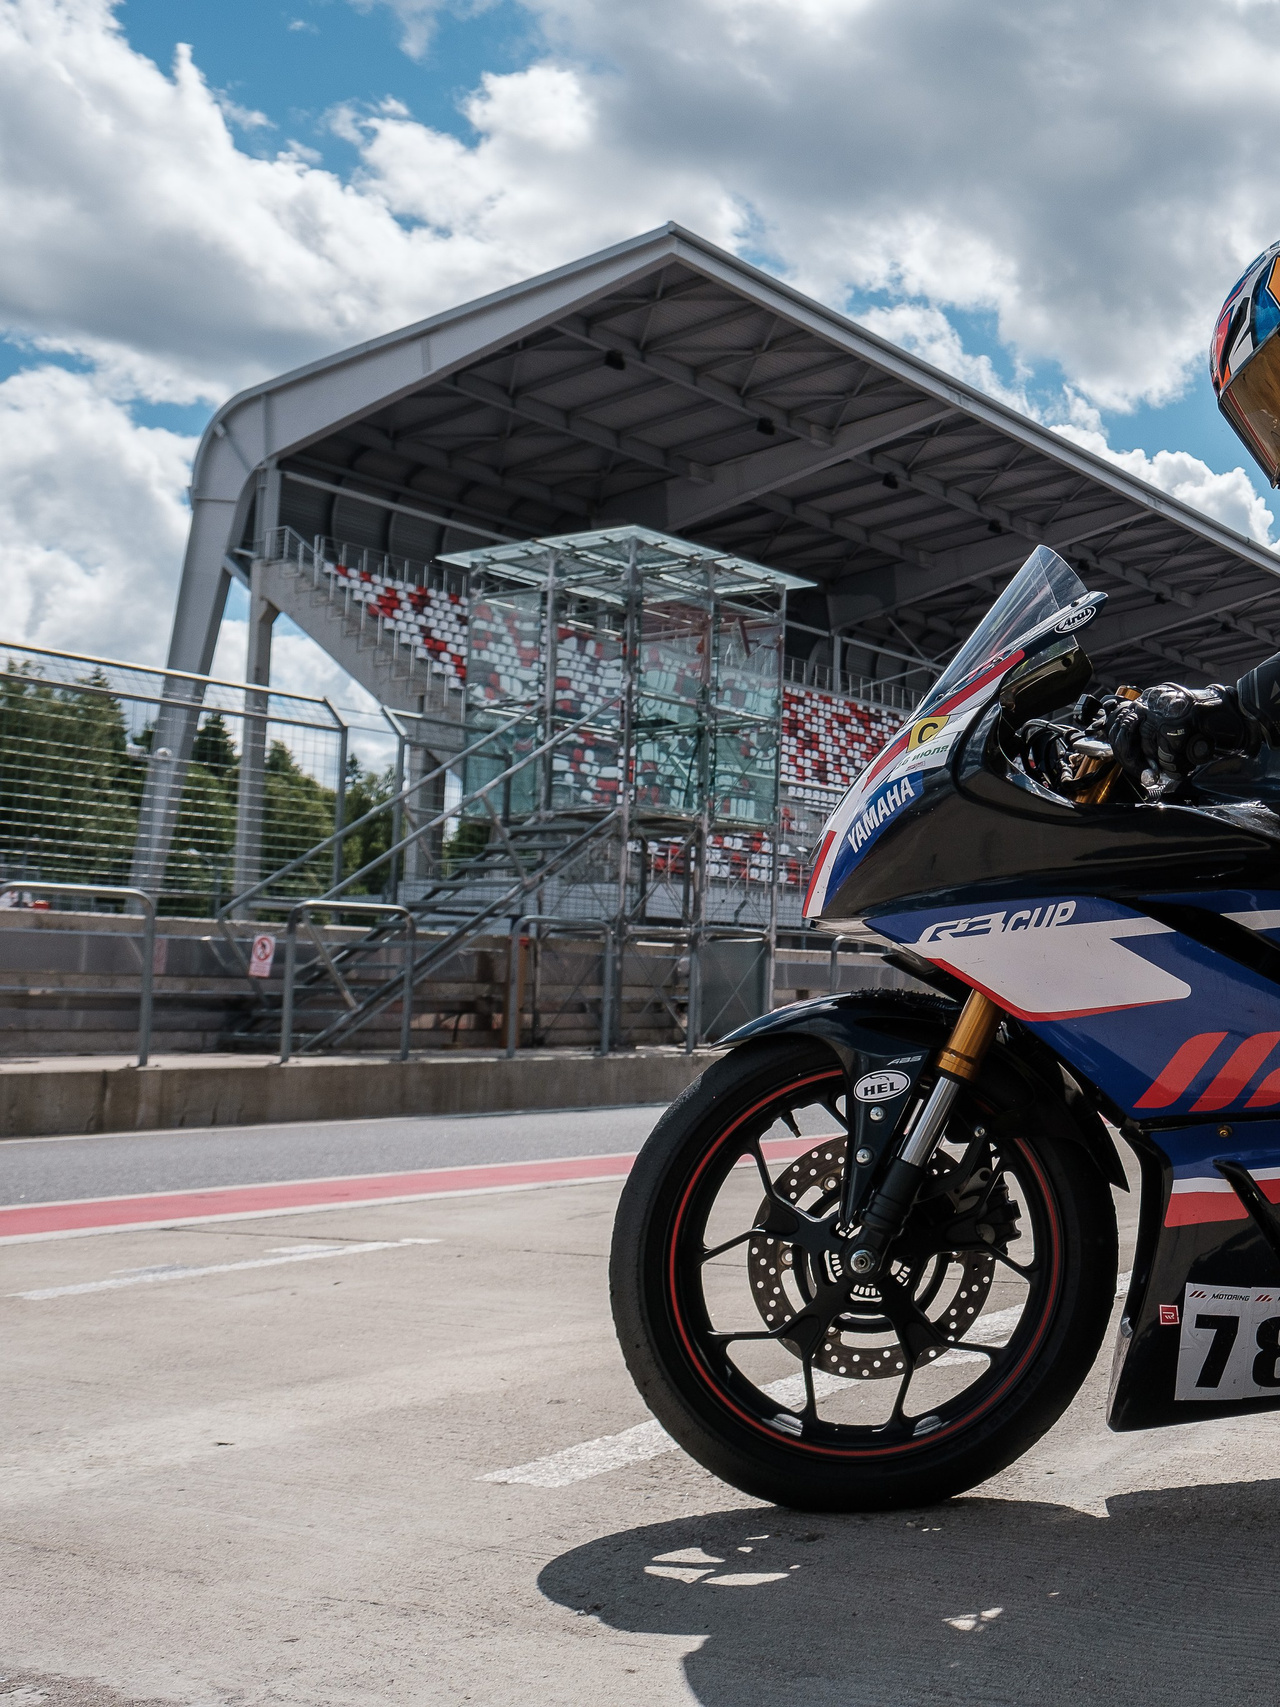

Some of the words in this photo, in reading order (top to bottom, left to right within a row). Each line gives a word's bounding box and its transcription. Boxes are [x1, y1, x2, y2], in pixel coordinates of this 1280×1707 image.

[1059, 607, 1092, 631] Arai
[912, 744, 949, 762] ИЮЛЯ
[847, 776, 916, 854] YAMAHA
[1001, 900, 1077, 933] CUP
[886, 1055, 923, 1067] ABS
[863, 1081, 900, 1097] HEL
[1211, 1293, 1250, 1302] MOTORING
